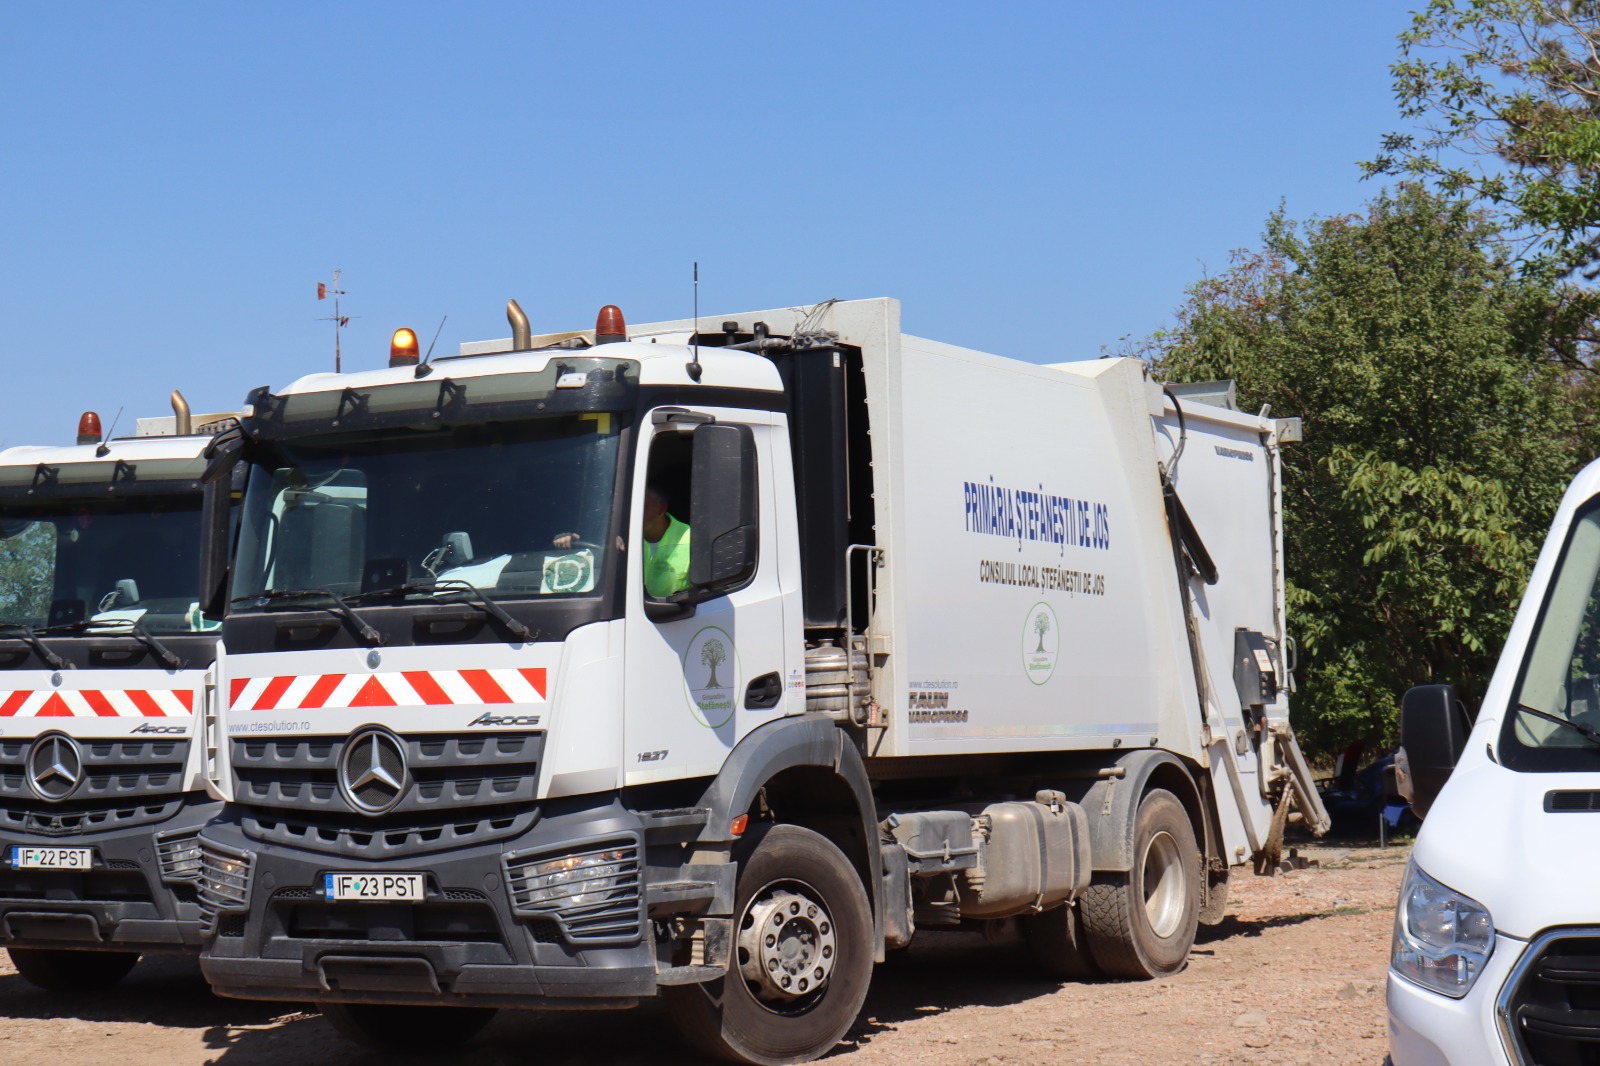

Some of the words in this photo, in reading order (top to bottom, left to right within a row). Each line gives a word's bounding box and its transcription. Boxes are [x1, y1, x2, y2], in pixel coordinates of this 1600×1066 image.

[964, 474, 1015, 538] PRIMĂRIA
[1077, 500, 1091, 548] DE
[1092, 502, 1109, 551] JOS
[980, 559, 1015, 586] CONSILIUL
[1018, 564, 1038, 588] LOCAL
[1082, 572, 1091, 595] DE
[1092, 574, 1104, 596] JOS
[909, 680, 958, 689] www.ctesolution.ro
[908, 691, 948, 709] FAUN
[908, 709, 968, 724] VARIOPRESS
[228, 720, 310, 732] www.ctesolution.ro
[22, 849, 34, 865] IF
[39, 850, 55, 866] 22
[59, 850, 86, 867] PST
[337, 876, 352, 897] IF
[359, 876, 379, 897] 23
[383, 876, 416, 897] PST
